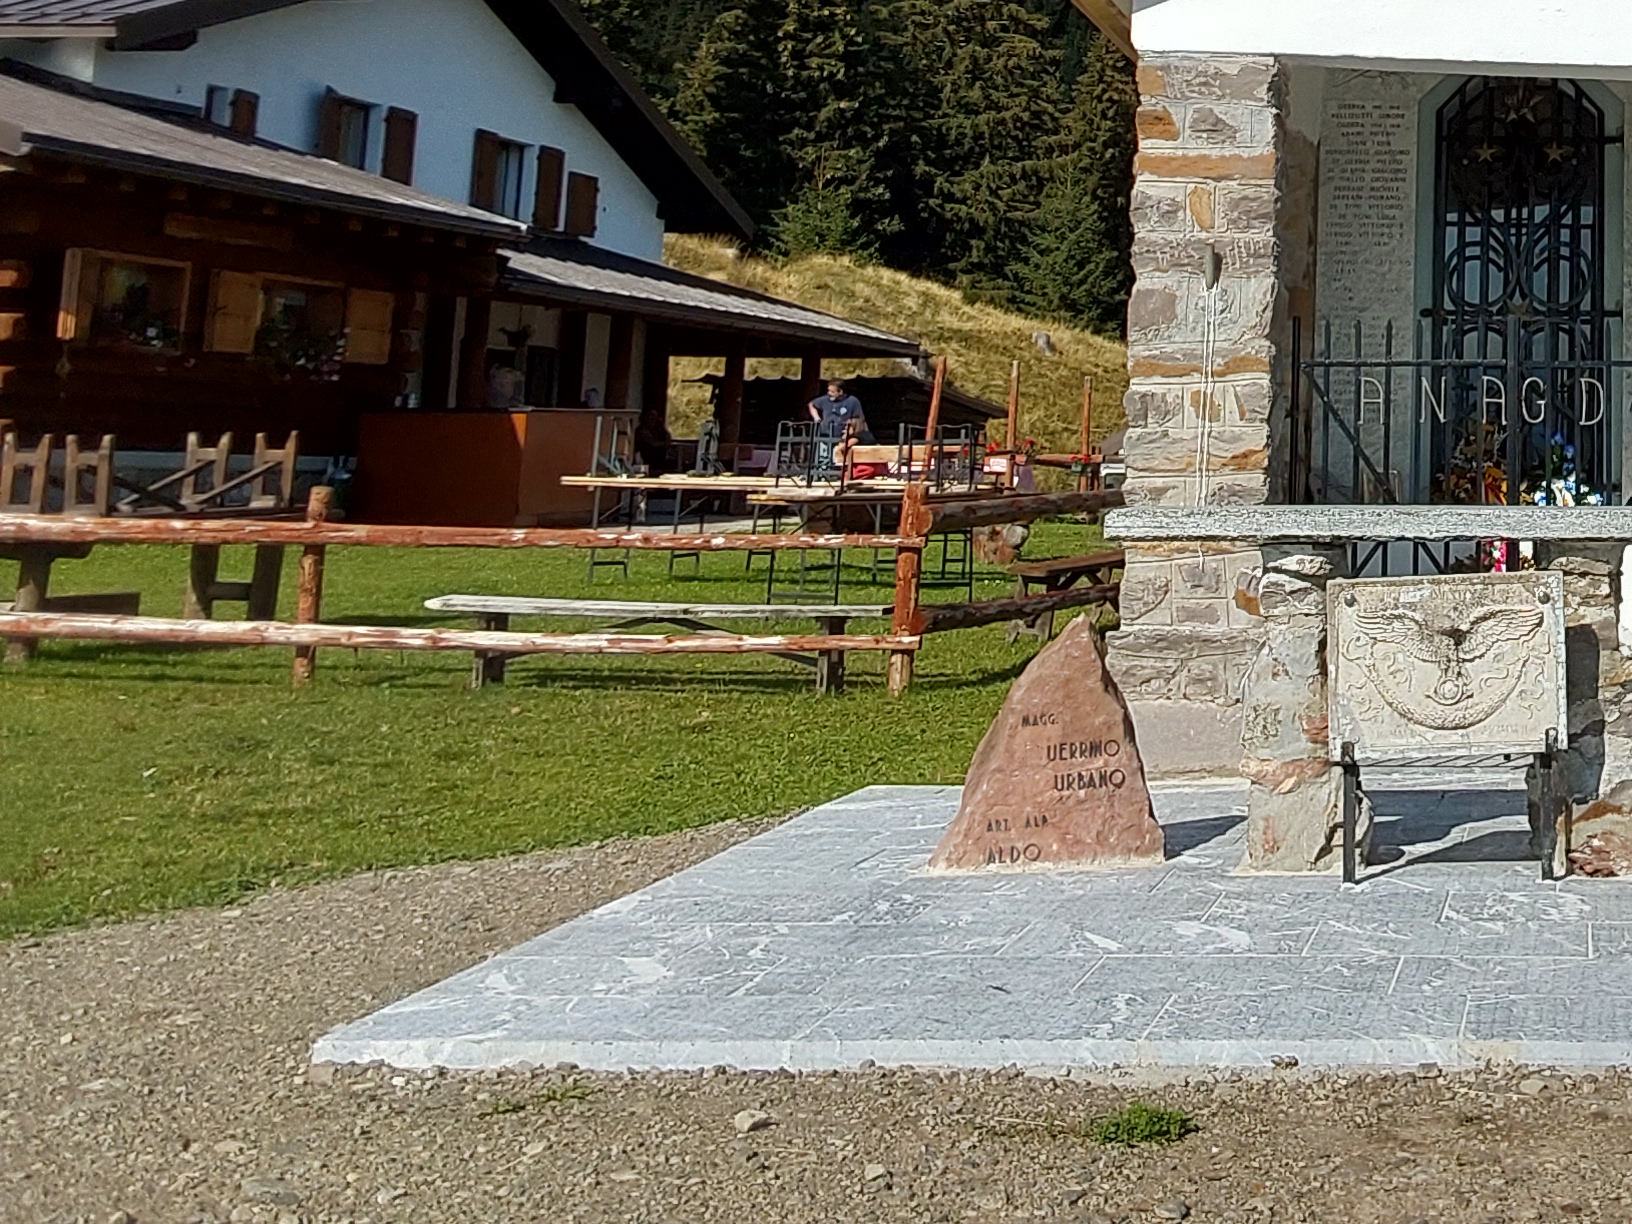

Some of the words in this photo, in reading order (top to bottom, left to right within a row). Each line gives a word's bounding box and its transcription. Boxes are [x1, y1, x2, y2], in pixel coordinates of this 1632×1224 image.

[1021, 712, 1060, 728] MAGG.
[1053, 768, 1127, 792] URBANO
[985, 842, 1042, 866] ALDO
